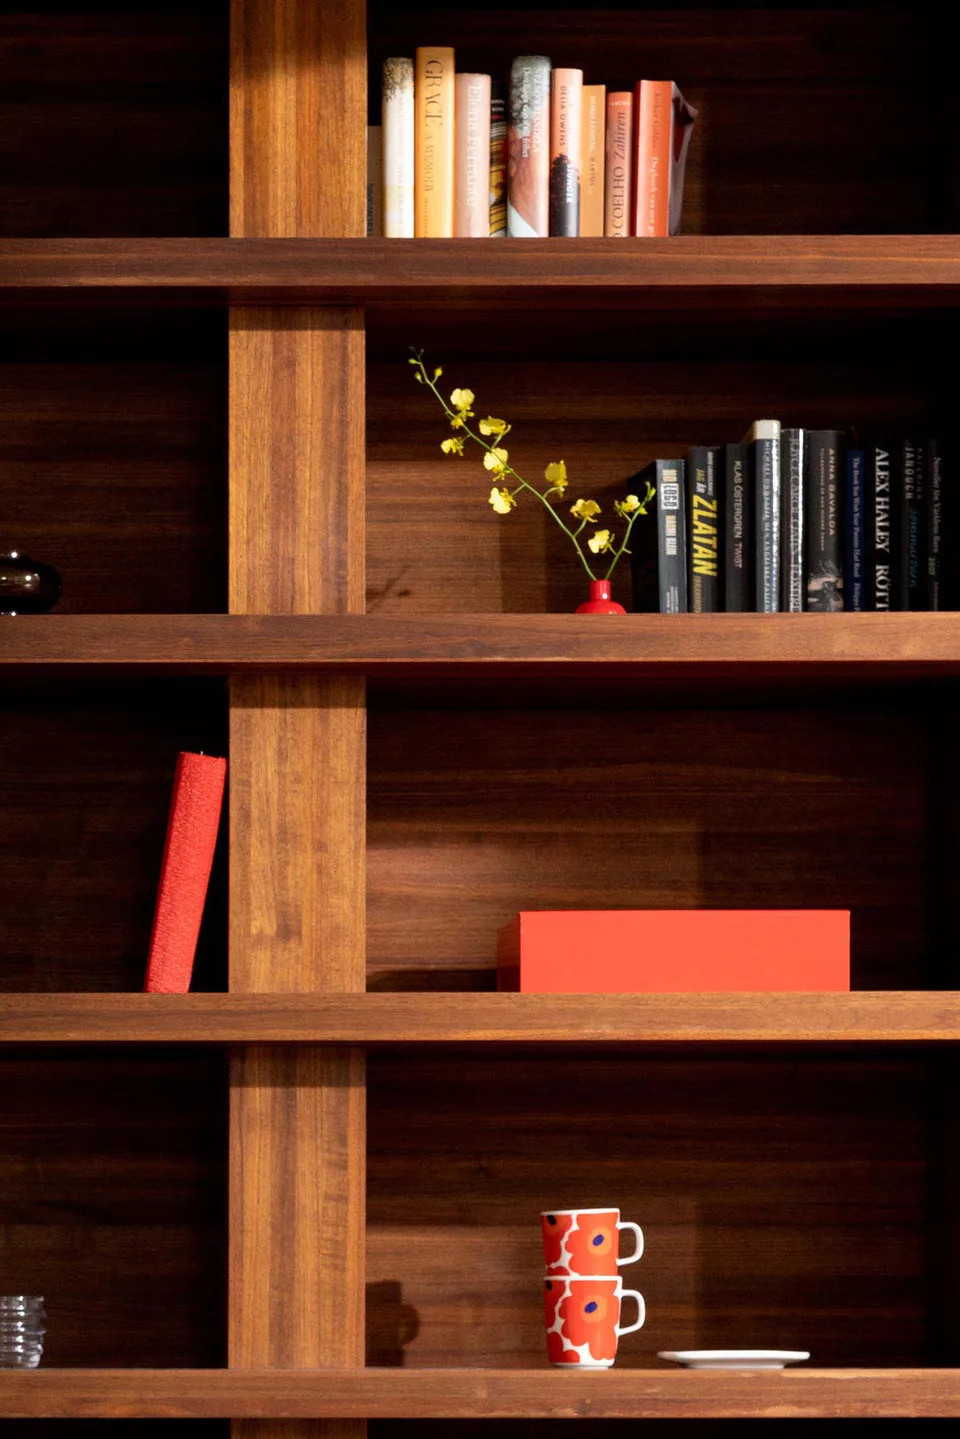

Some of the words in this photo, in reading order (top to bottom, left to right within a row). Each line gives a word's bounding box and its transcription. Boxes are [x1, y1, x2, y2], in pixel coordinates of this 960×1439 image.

[424, 60, 443, 127] GRACE
[559, 85, 567, 110] DELIA
[613, 112, 626, 160] Zahiren
[652, 120, 660, 149] Golden
[423, 144, 435, 192] MEMOIR
[467, 136, 482, 207] Ferrante
[611, 166, 625, 229] COELHO
[734, 460, 742, 484] KLAS
[790, 438, 799, 472] JOYCE
[828, 448, 836, 480] ANNA
[852, 457, 860, 468] The
[875, 447, 890, 493] ALEX
[852, 469, 860, 485] Book
[904, 446, 915, 500] JANOUCH
[662, 484, 678, 509] LOGO
[790, 475, 799, 516] CAROL
[852, 486, 860, 497] You
[852, 497, 860, 512] Wish
[734, 485, 743, 538] ÖSTERGREN
[828, 484, 836, 536] GAVALDA
[852, 513, 860, 526] Your
[875, 496, 890, 554] HALEY
[692, 494, 718, 577] ZLATAN
[791, 519, 800, 554] OATES
[734, 542, 742, 568] TWIST
[852, 562, 860, 578] Read
[790, 564, 800, 612] FOXFIRE
